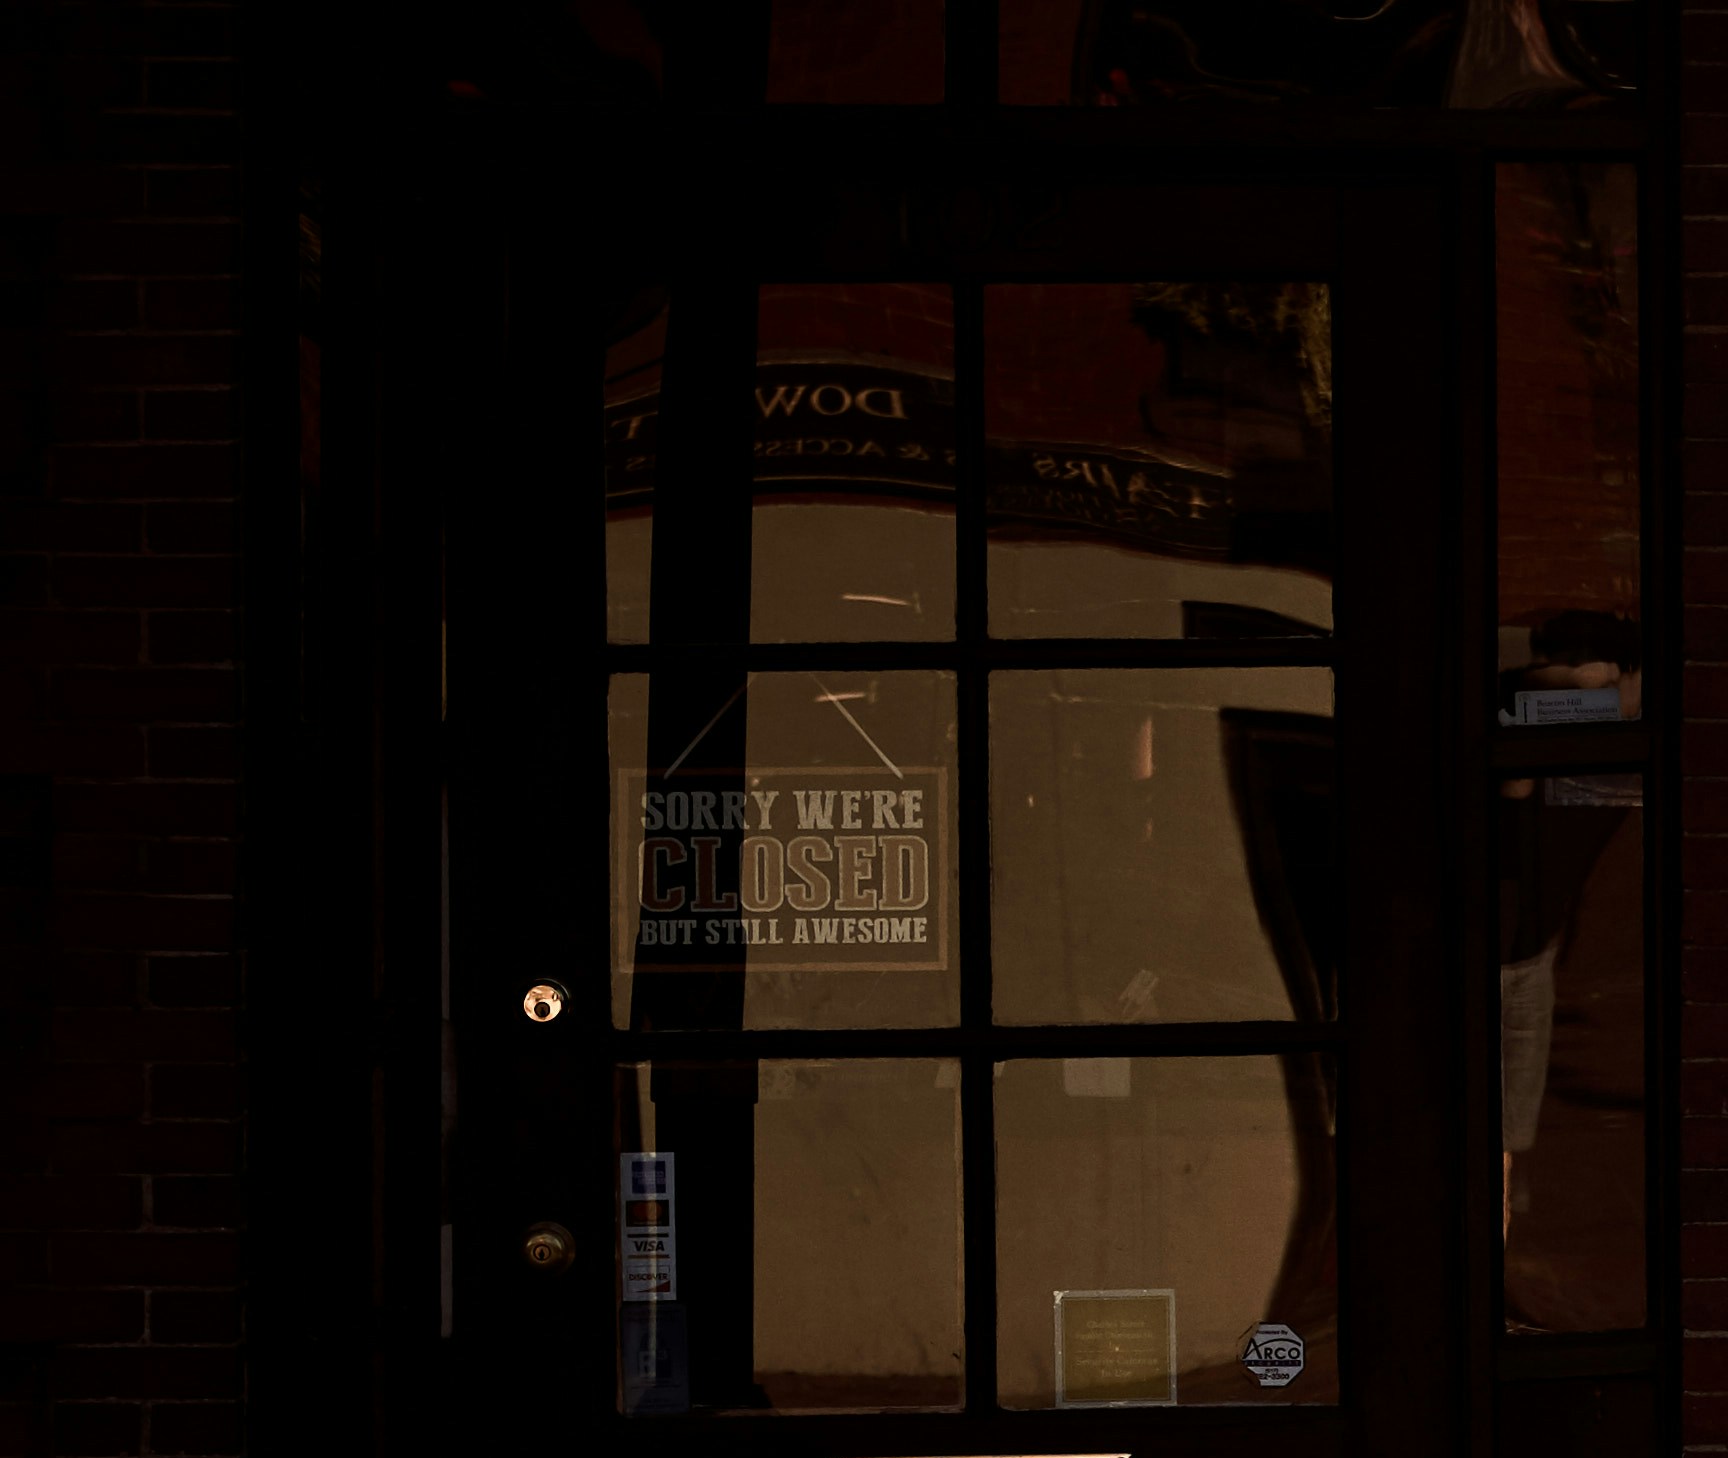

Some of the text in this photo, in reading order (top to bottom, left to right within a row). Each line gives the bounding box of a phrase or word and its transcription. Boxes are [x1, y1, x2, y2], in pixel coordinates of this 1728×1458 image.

[641, 790, 924, 830] SORRY WE'RE
[638, 836, 929, 912] CLOSED
[639, 917, 928, 946] BUT STILL AWESOME
[634, 1240, 665, 1252] VISA
[628, 1273, 668, 1281] DISCOVER
[1242, 1337, 1301, 1360] ARCO
